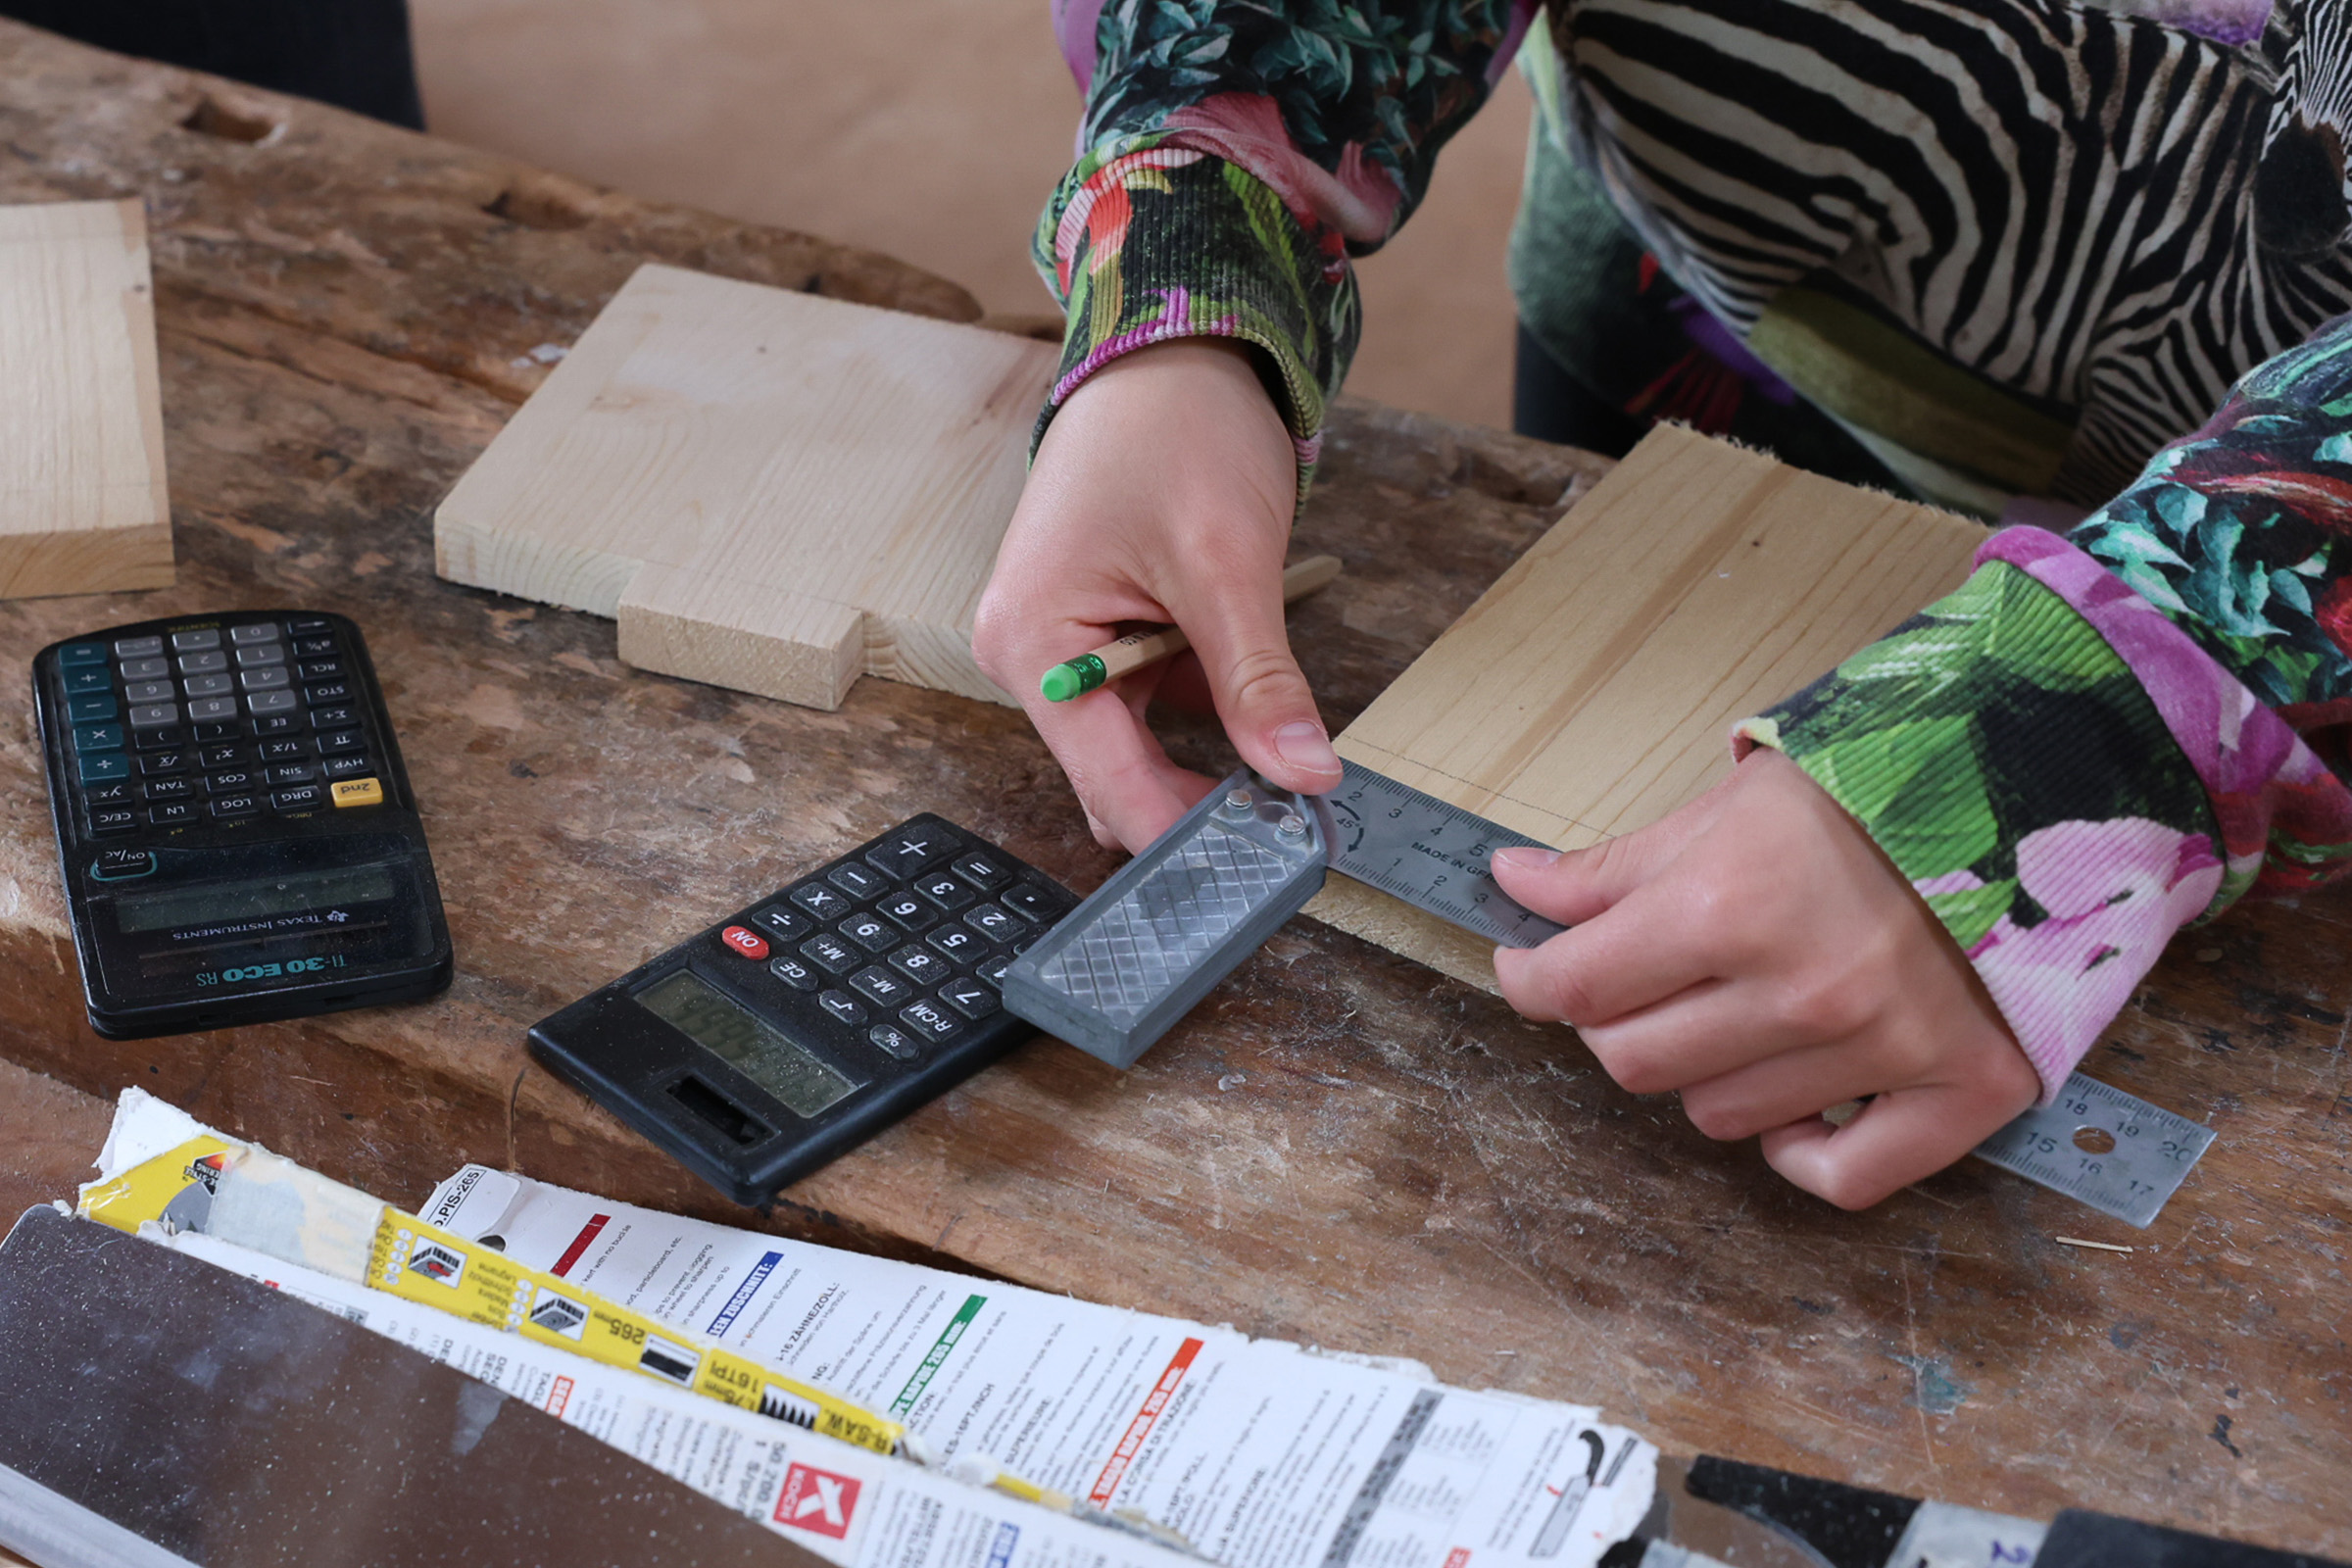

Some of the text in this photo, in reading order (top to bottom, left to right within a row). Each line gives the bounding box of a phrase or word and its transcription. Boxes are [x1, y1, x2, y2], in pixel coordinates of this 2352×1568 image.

[311, 663, 336, 672] RCL
[318, 686, 344, 696] STO
[209, 702, 220, 710] 8
[269, 695, 278, 704] 7
[335, 759, 363, 768] HYP
[219, 774, 246, 783] COS
[156, 781, 184, 791] TAN
[341, 783, 370, 794] 2nd
[281, 791, 312, 801] DRG
[1348, 791, 1362, 802] 2
[221, 798, 251, 808] LOG
[167, 806, 184, 814] LN
[1389, 808, 1402, 818] 3
[100, 812, 131, 822] CE/C
[1431, 827, 1443, 836] 4
[106, 849, 145, 861] ON/AC
[1411, 842, 1451, 862] MADE
[1451, 859, 1464, 869] IN
[1469, 844, 1488, 857] 5
[1393, 858, 1403, 866] 1
[1434, 875, 1447, 886] 2
[932, 882, 955, 895] 3
[1475, 894, 1489, 904] 3
[895, 902, 916, 915] 6
[983, 912, 1006, 925] 2
[1518, 913, 1533, 922] 4
[172, 914, 320, 940] TEXAS INSTRUMENTS
[858, 923, 880, 936] 9
[731, 931, 760, 948] ON
[943, 934, 967, 948] 5
[817, 942, 845, 959] M+
[906, 955, 930, 968] 8
[223, 962, 281, 982] ECO
[779, 962, 806, 978] CE
[196, 972, 218, 986] RS
[956, 991, 981, 1004] 7
[2065, 1099, 2087, 1116] 18
[2116, 1122, 2139, 1137] 19
[2026, 1132, 2058, 1153] 15
[2157, 1141, 2193, 1161] 20
[2080, 1157, 2103, 1174] 16
[182, 1165, 219, 1187] E-STYLE
[2130, 1180, 2154, 1196] 17
[593, 1253, 607, 1269] with
[605, 1245, 613, 1255] no
[722, 1258, 773, 1319] ZUSCHNITT:
[708, 1360, 760, 1393] 16TPI
[778, 1467, 806, 1519] KOCH
